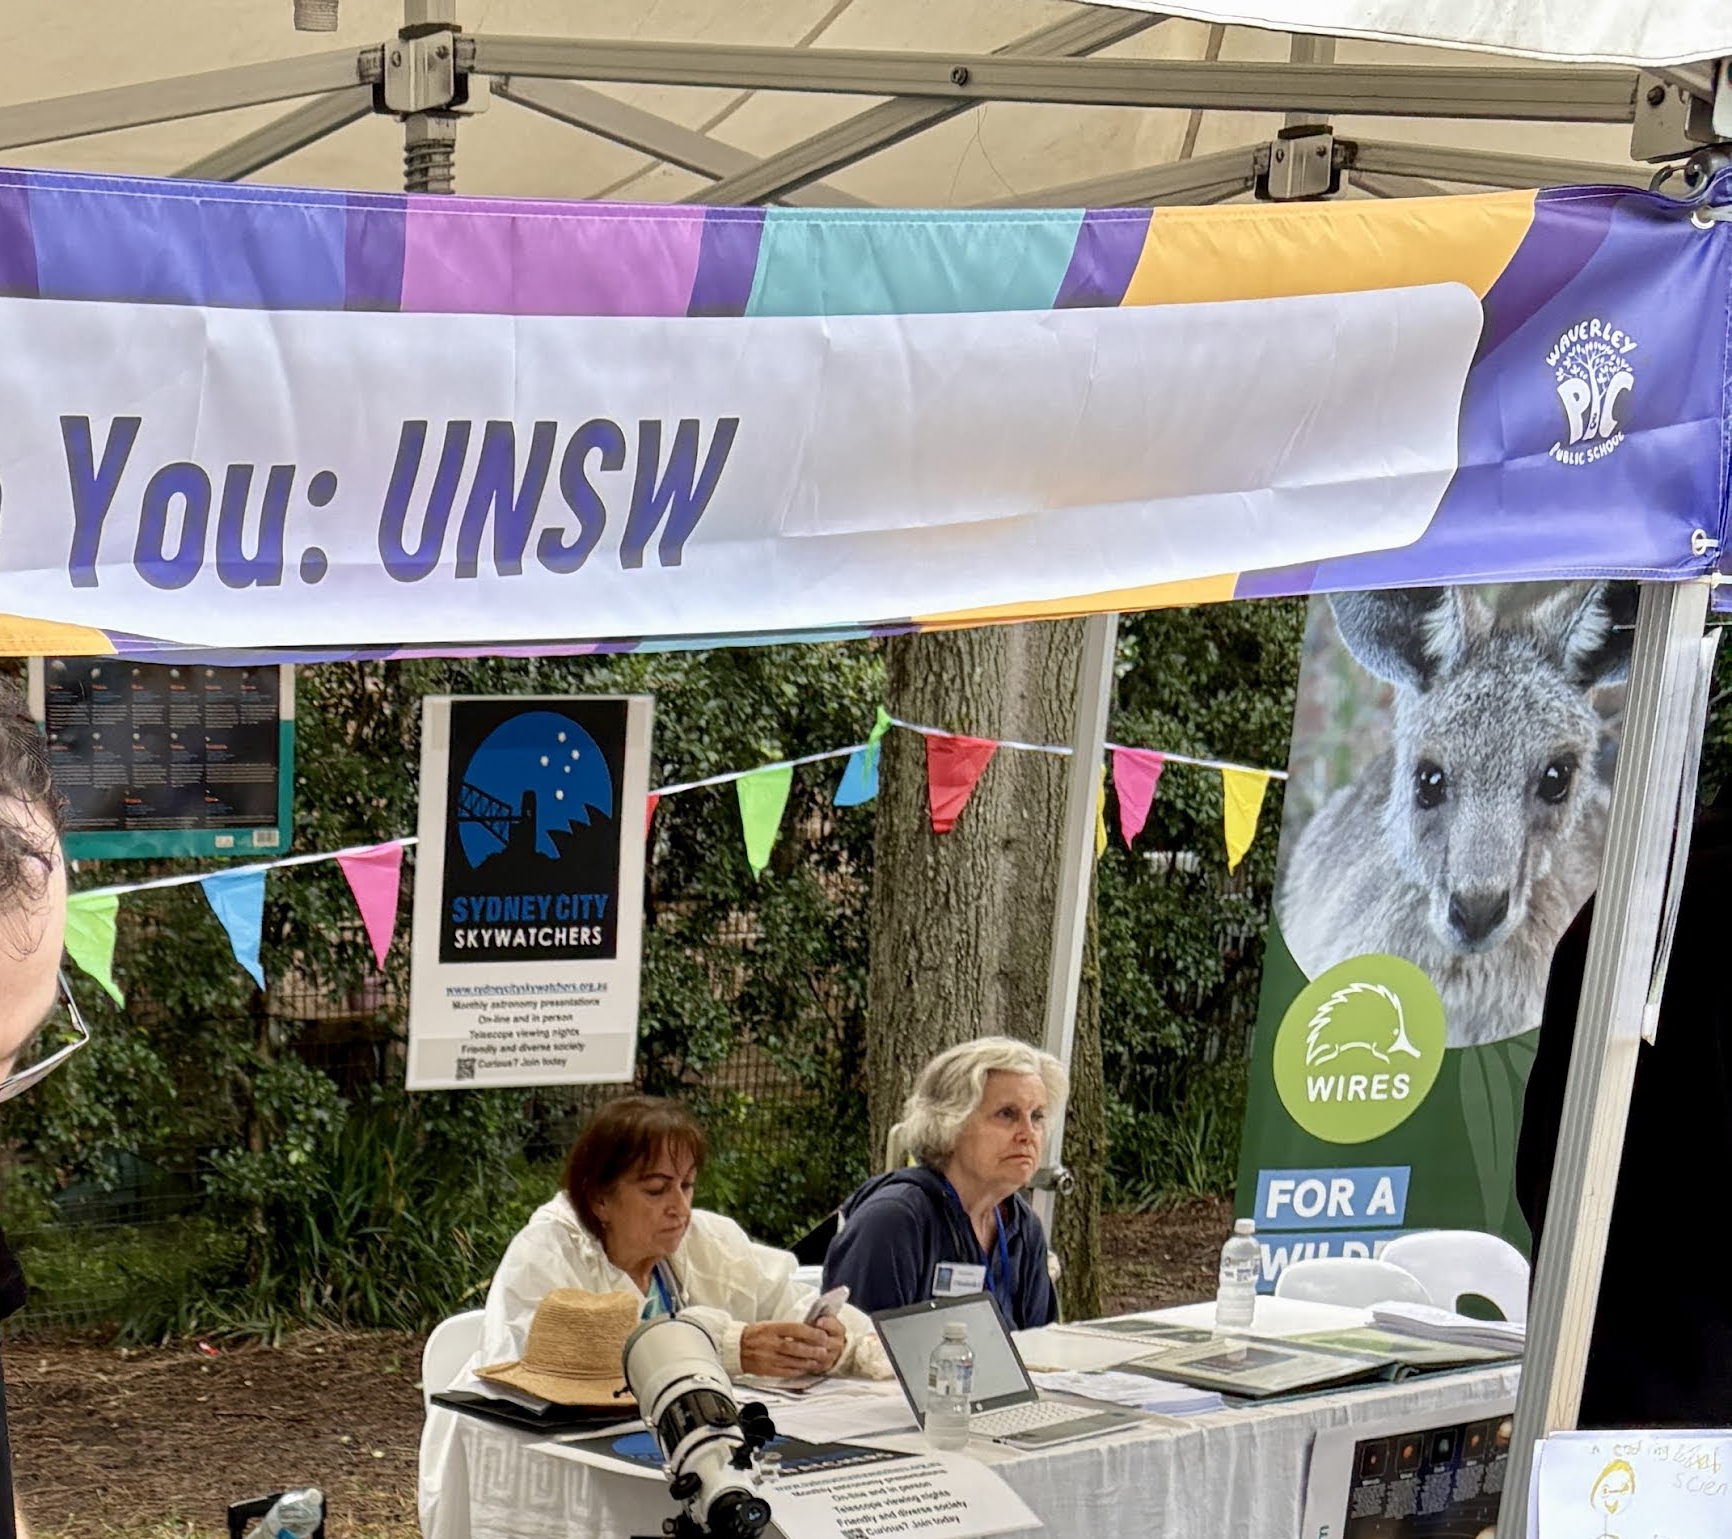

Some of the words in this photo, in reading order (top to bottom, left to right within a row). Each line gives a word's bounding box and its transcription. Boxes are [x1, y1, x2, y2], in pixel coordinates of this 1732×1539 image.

[1546, 318, 1637, 366] WAVERLEY
[1548, 442, 1585, 465] PUBLIC
[1588, 432, 1625, 463] SCHOOL
[59, 415, 341, 591] You:
[378, 415, 742, 585] UNSW
[452, 895, 550, 923] SYDNEY
[555, 894, 608, 920] CITY
[454, 926, 602, 949] SKYWATCHERS
[452, 1000, 487, 1010] Monthly
[490, 1000, 537, 1009] astronomy
[513, 1014, 529, 1023] and
[532, 1013, 540, 1022] in
[542, 1014, 573, 1023] person
[469, 1030, 513, 1040] Telescope
[516, 1029, 550, 1039] viewing
[552, 1028, 580, 1038] nights
[461, 1045, 497, 1054] Friendly
[501, 1044, 516, 1052] and
[519, 1043, 551, 1052] diverse
[520, 1058, 540, 1066] Join
[543, 1057, 567, 1067] today
[1307, 1074, 1410, 1102] WIRES
[1266, 1178, 1354, 1219] FOR
[1366, 1176, 1396, 1216] A
[890, 1486, 897, 1494] in
[834, 1501, 882, 1514] Telescope
[921, 1490, 951, 1502] nights
[837, 1514, 877, 1526] Friendly
[879, 1511, 897, 1521] and
[898, 1505, 932, 1516] diverse
[934, 1501, 968, 1513] society
[912, 1518, 933, 1529] Join
[935, 1515, 960, 1526] today
